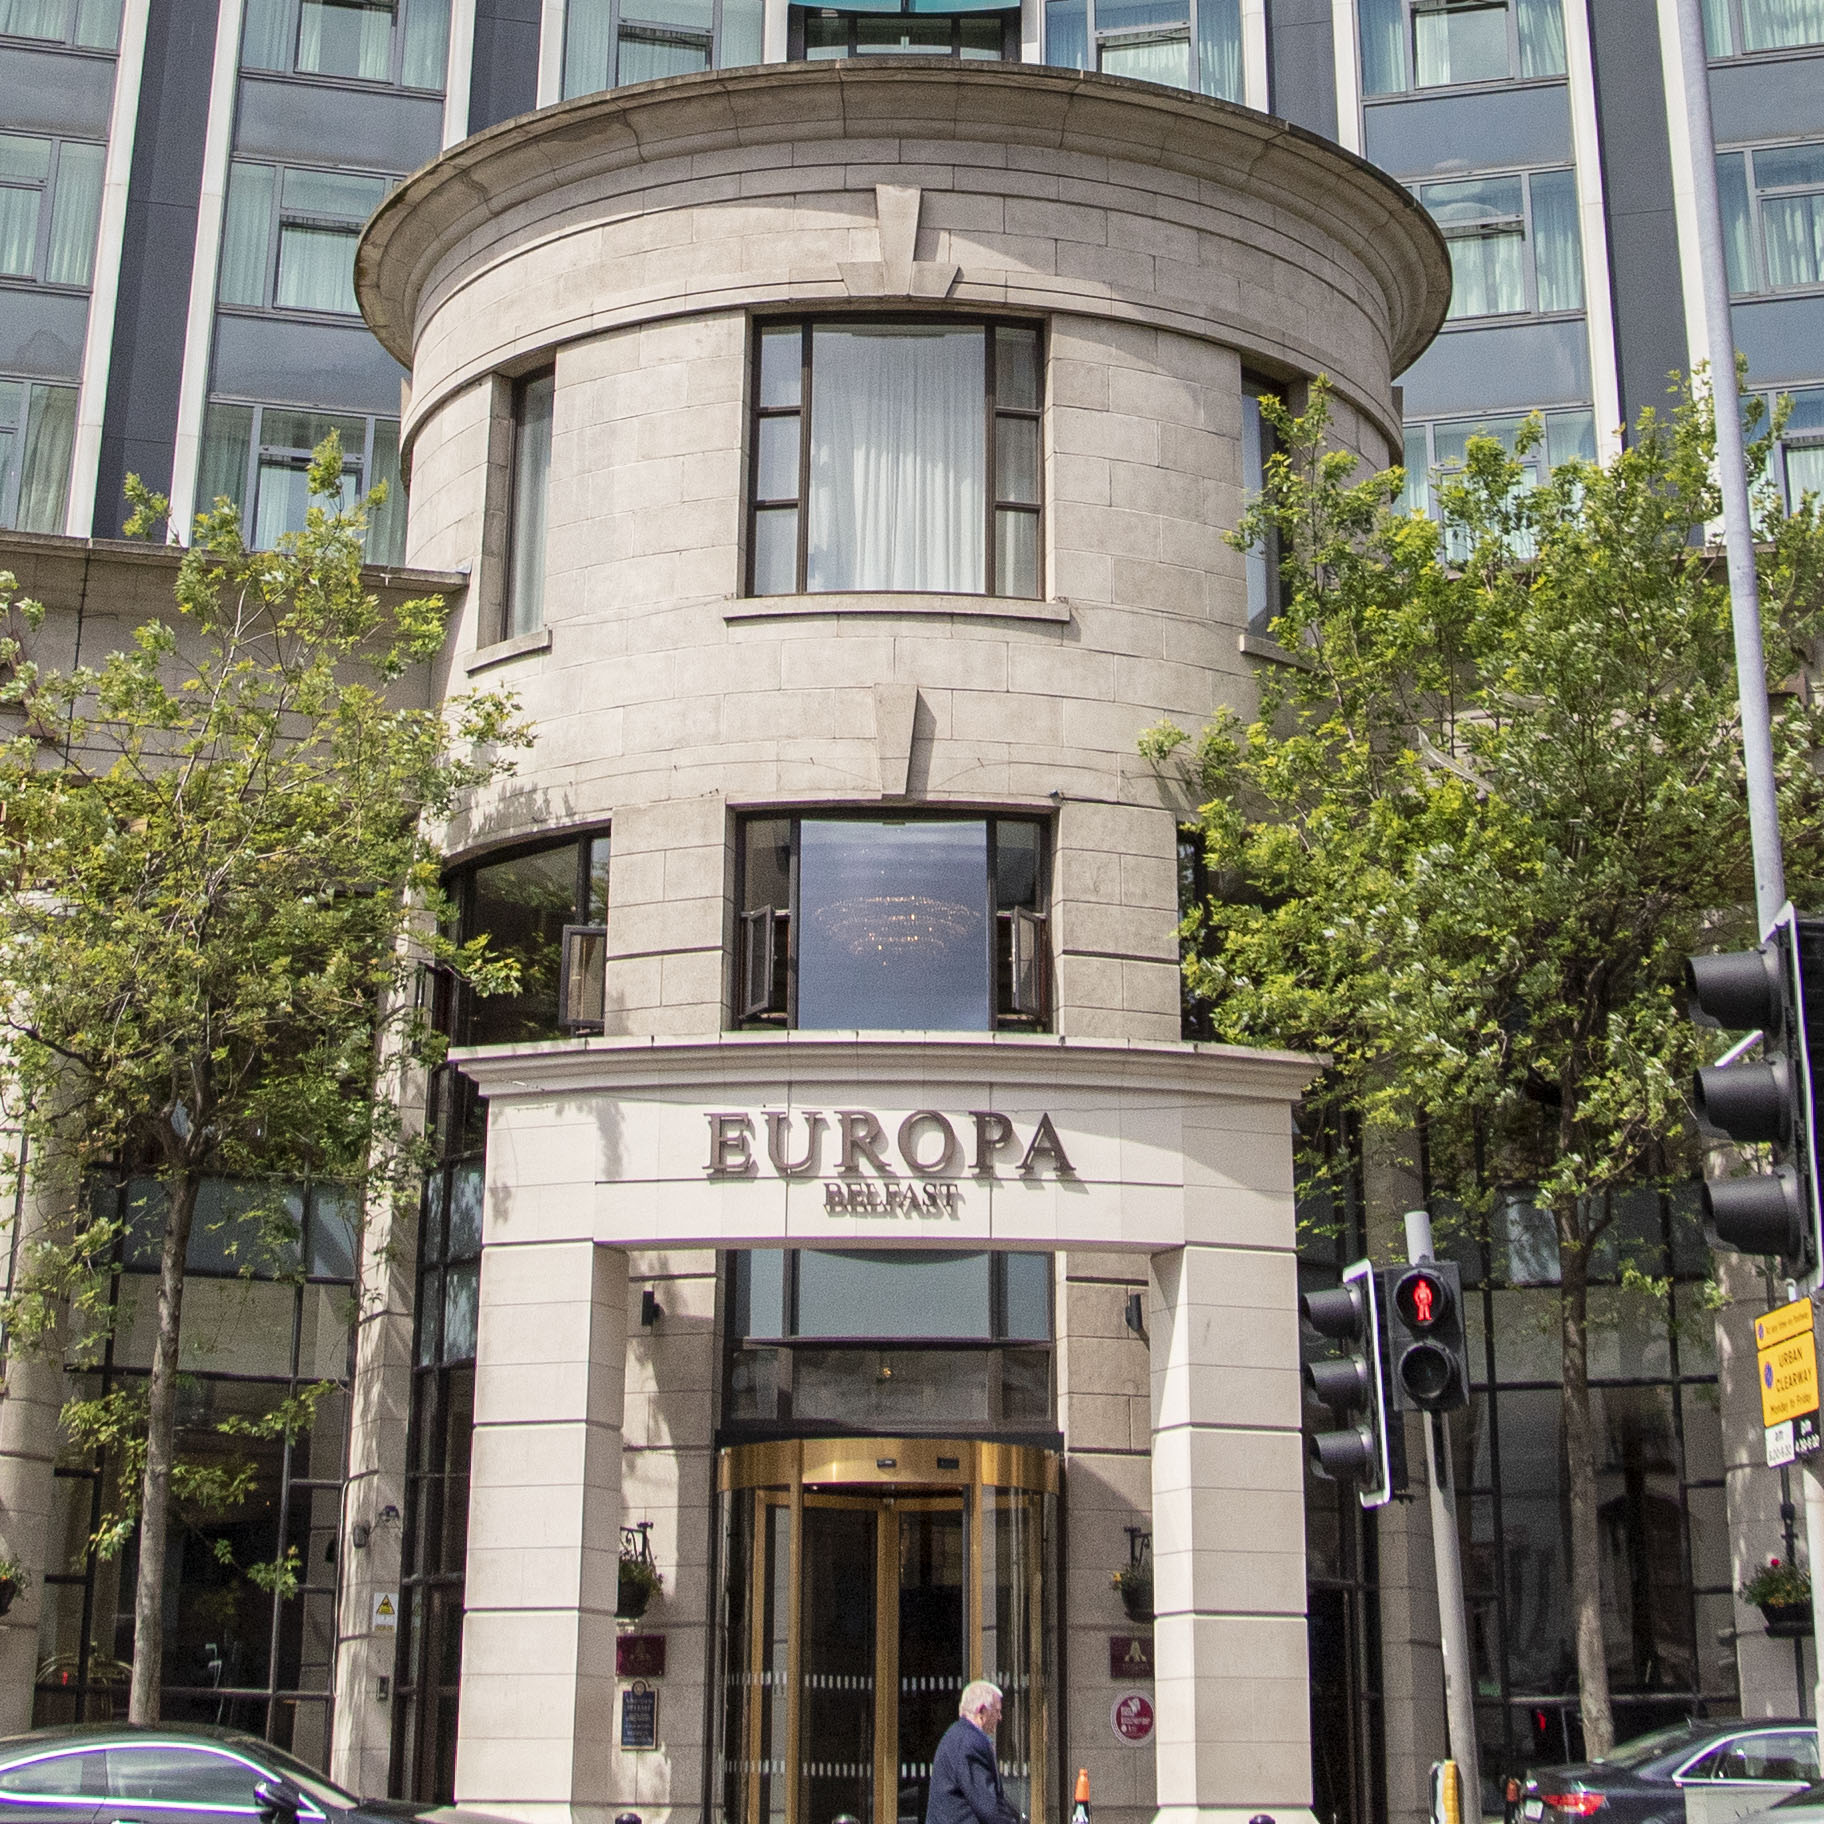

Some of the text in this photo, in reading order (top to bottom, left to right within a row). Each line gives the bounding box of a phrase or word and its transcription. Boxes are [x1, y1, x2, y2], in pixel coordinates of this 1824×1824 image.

[702, 1110, 1077, 1175] EUROPA
[824, 1182, 959, 1208] BELFAST
[1778, 1347, 1803, 1369] URBAN
[1776, 1368, 1812, 1393] CLEARWAY
